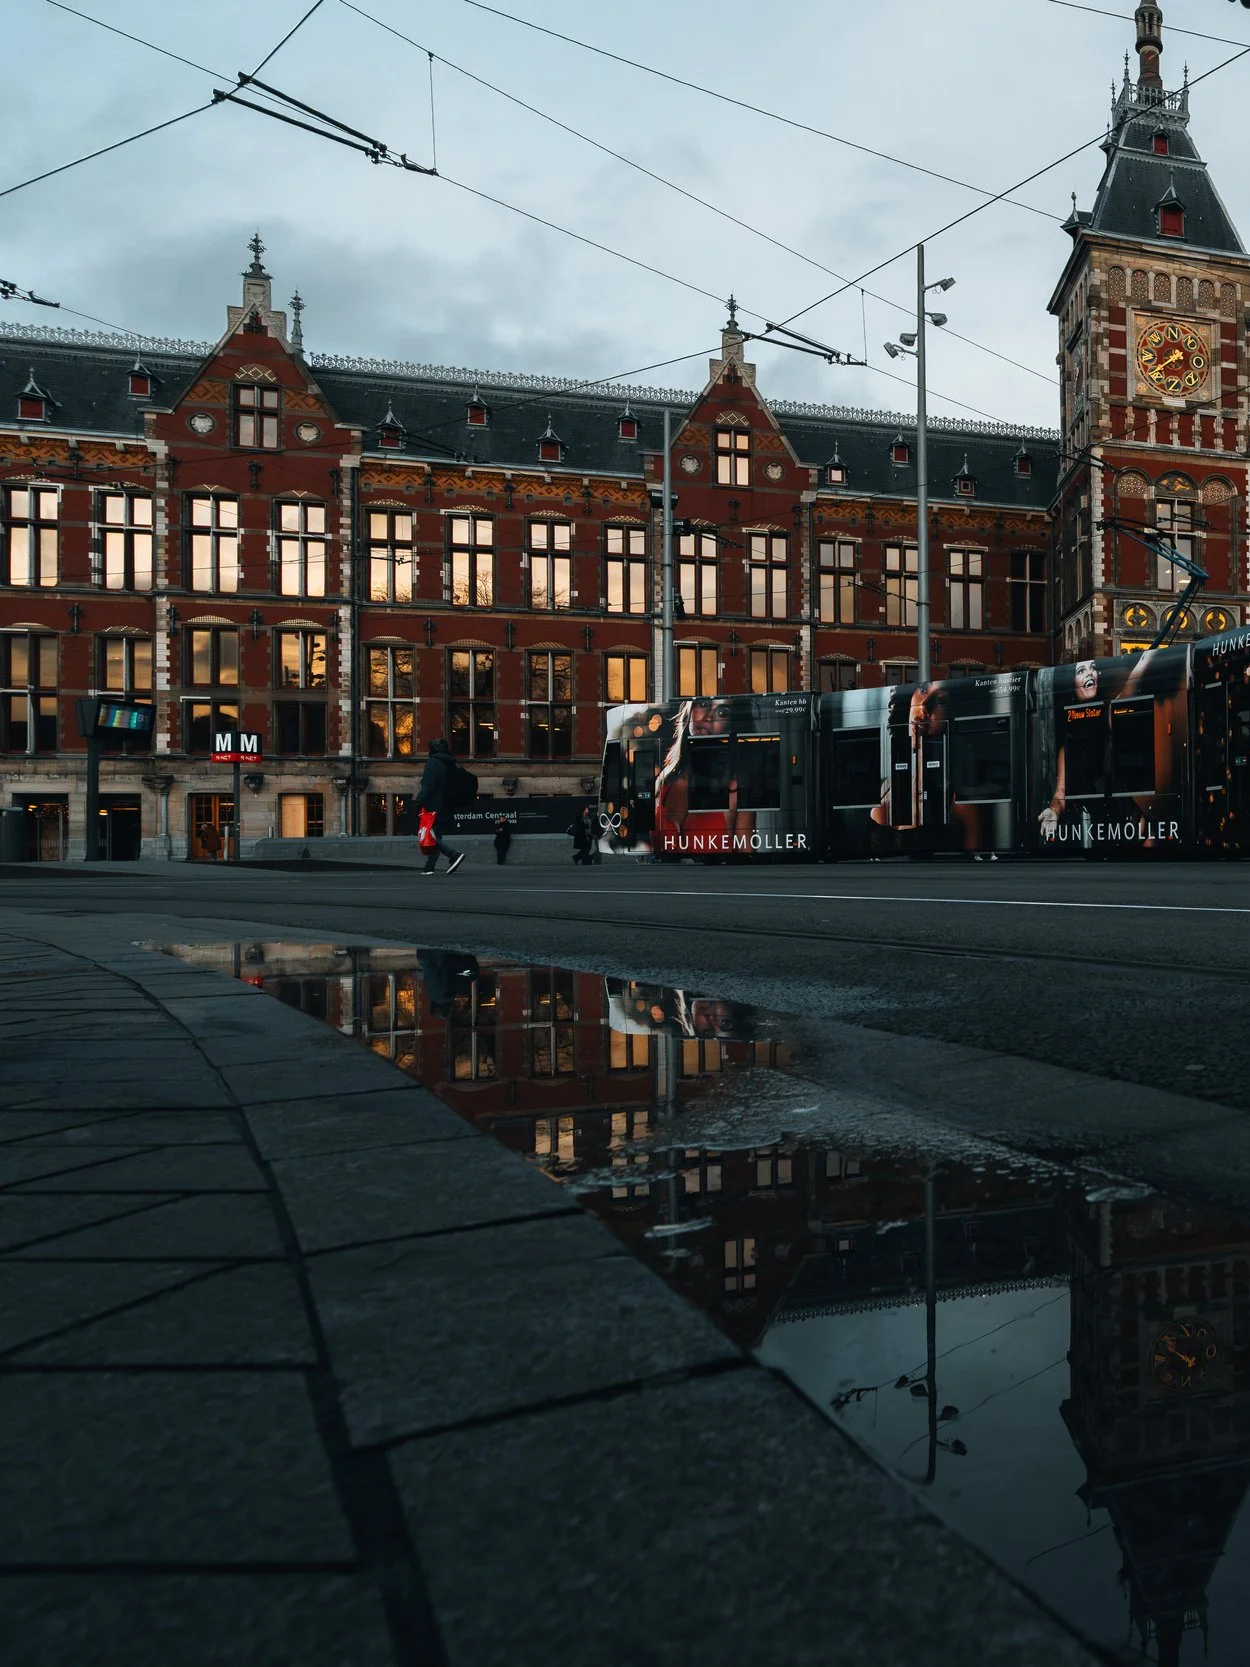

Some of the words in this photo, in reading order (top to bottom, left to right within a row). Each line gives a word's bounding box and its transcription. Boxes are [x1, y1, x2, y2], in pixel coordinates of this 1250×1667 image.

[1168, 327, 1178, 340] N
[1192, 356, 1204, 369] O
[1168, 379, 1179, 392] Z
[215, 733, 232, 752] M
[240, 733, 258, 753] M
[1044, 816, 1180, 842] HUNKEMÖLLER
[664, 829, 808, 850] HUNKEMÖLLER
